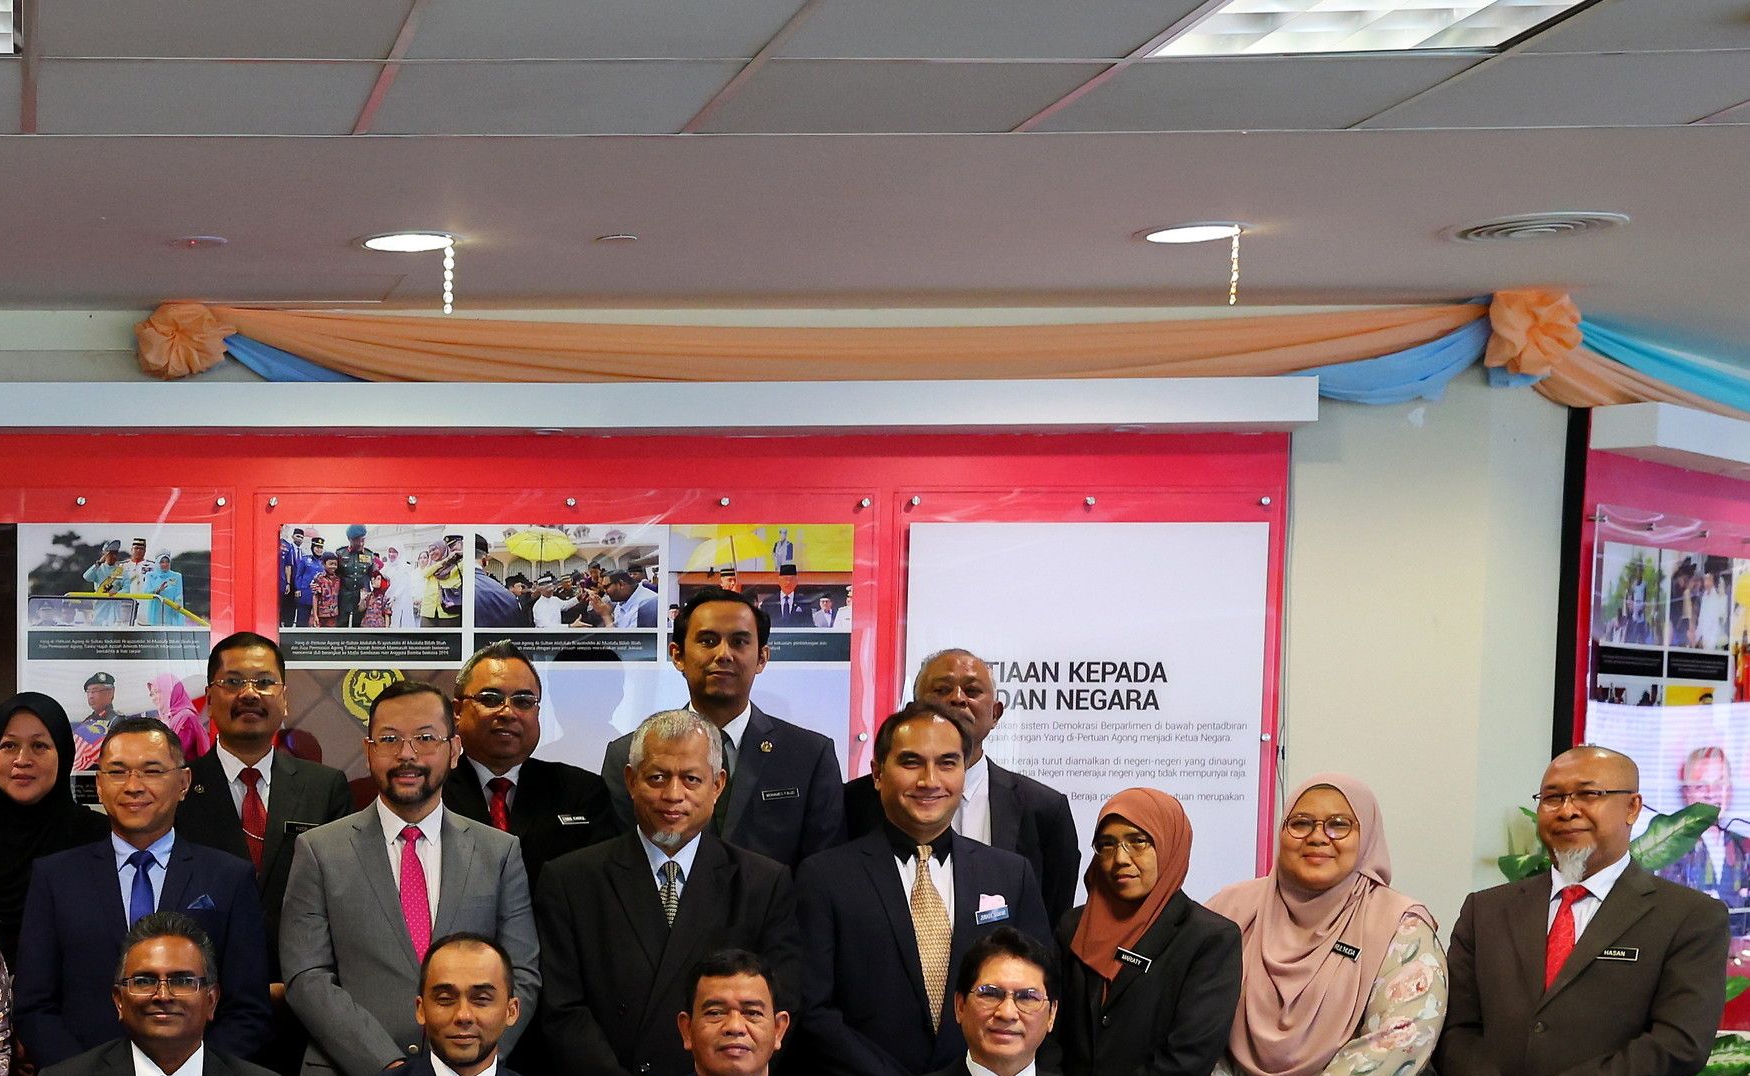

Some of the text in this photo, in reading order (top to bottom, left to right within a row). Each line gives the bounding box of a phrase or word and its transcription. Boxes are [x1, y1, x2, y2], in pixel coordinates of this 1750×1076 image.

[1068, 661, 1168, 683] KEPADA
[996, 689, 1160, 710] DAN NEGARA
[1020, 721, 1050, 730] sistem
[1052, 721, 1098, 730] Demokrasi
[1100, 721, 1151, 732] Berparlimen
[1154, 721, 1163, 730] di
[1165, 722, 1194, 730] bawah
[1196, 722, 1248, 732] pentadbiran
[1043, 733, 1065, 744] Yang
[1066, 733, 1109, 742] di-Pertuan
[1111, 733, 1138, 743] Agong
[1140, 733, 1173, 744] menjadi
[1174, 733, 1199, 742] Ketua
[1041, 757, 1063, 765] turut
[1065, 757, 1111, 765] diamalkan
[1113, 757, 1122, 765] di
[1124, 757, 1182, 767] negeri-negeri
[1184, 759, 1206, 767] yang
[1208, 757, 1247, 767] dinaungi
[1135, 770, 1156, 779] yang
[1158, 769, 1177, 777] tidak
[1179, 769, 1229, 779] mempunyai
[1070, 792, 1098, 801] Beraja
[1197, 793, 1245, 802] merupakan
[1603, 949, 1627, 957] HASAN
